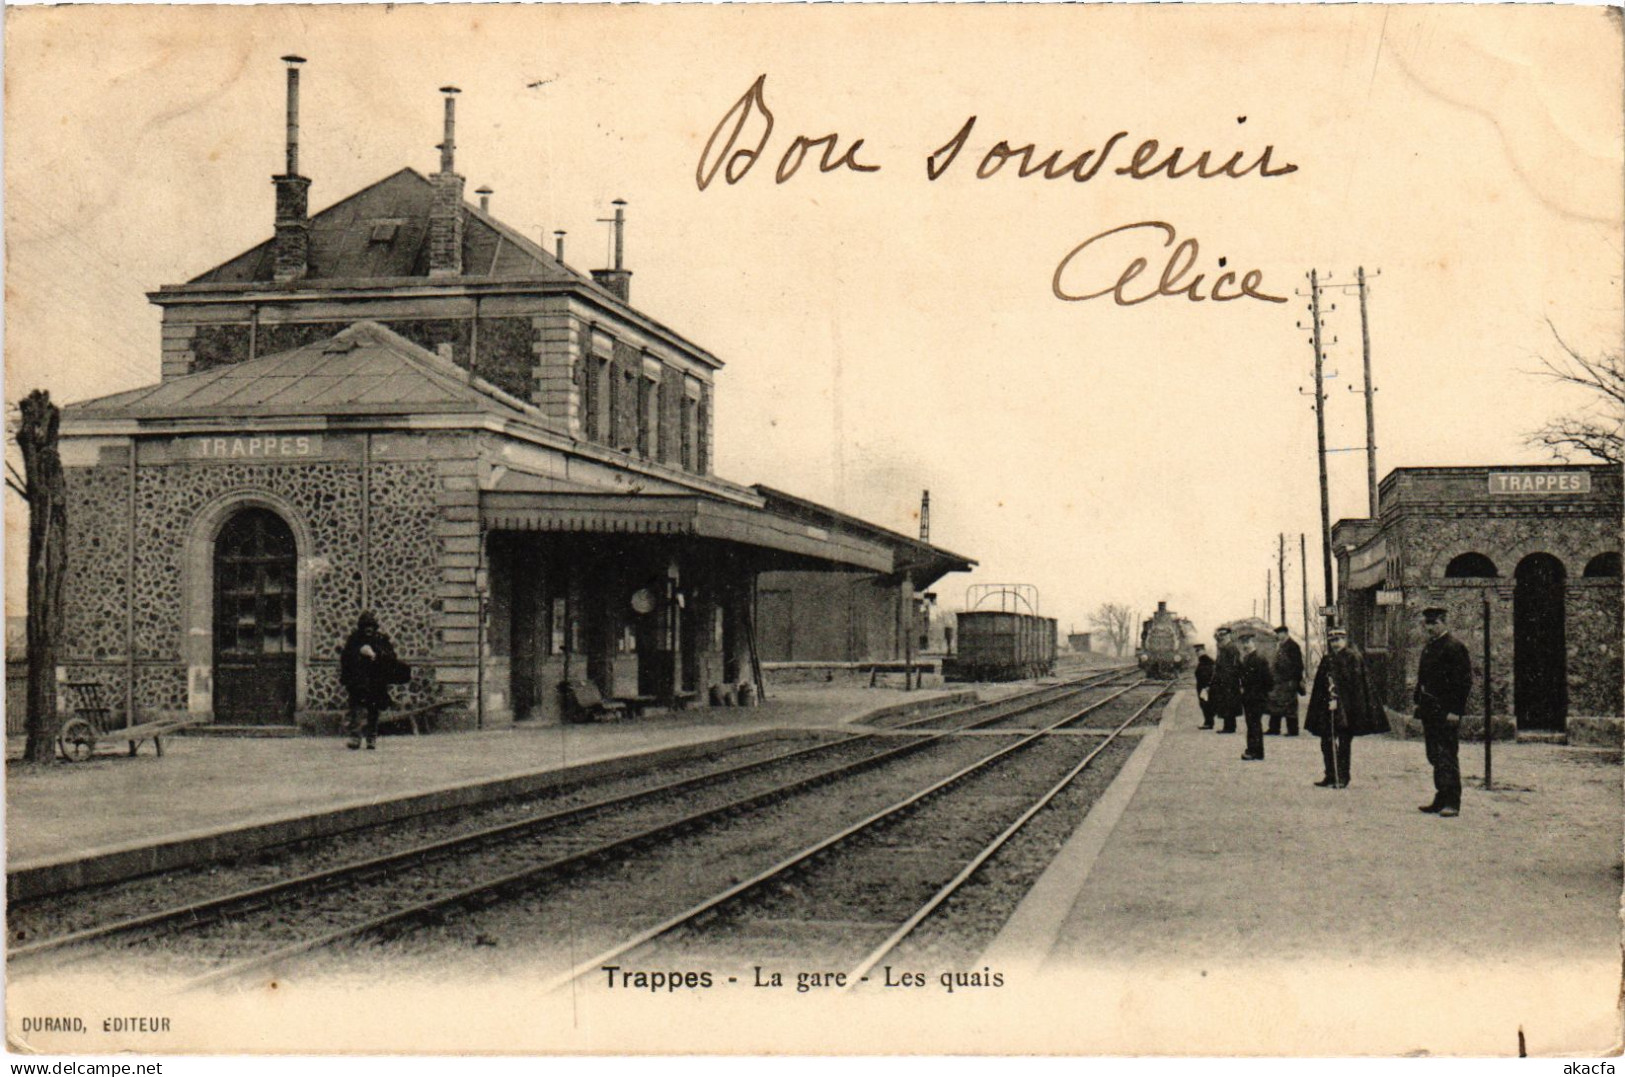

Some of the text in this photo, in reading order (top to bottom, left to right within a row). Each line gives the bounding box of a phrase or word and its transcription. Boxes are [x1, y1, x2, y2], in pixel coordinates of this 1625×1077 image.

[695, 73, 1299, 192] Bon souvenir
[1052, 220, 1289, 306] Alice
[199, 436, 310, 457] TRAPPES
[1498, 475, 1581, 491] TRAPPES
